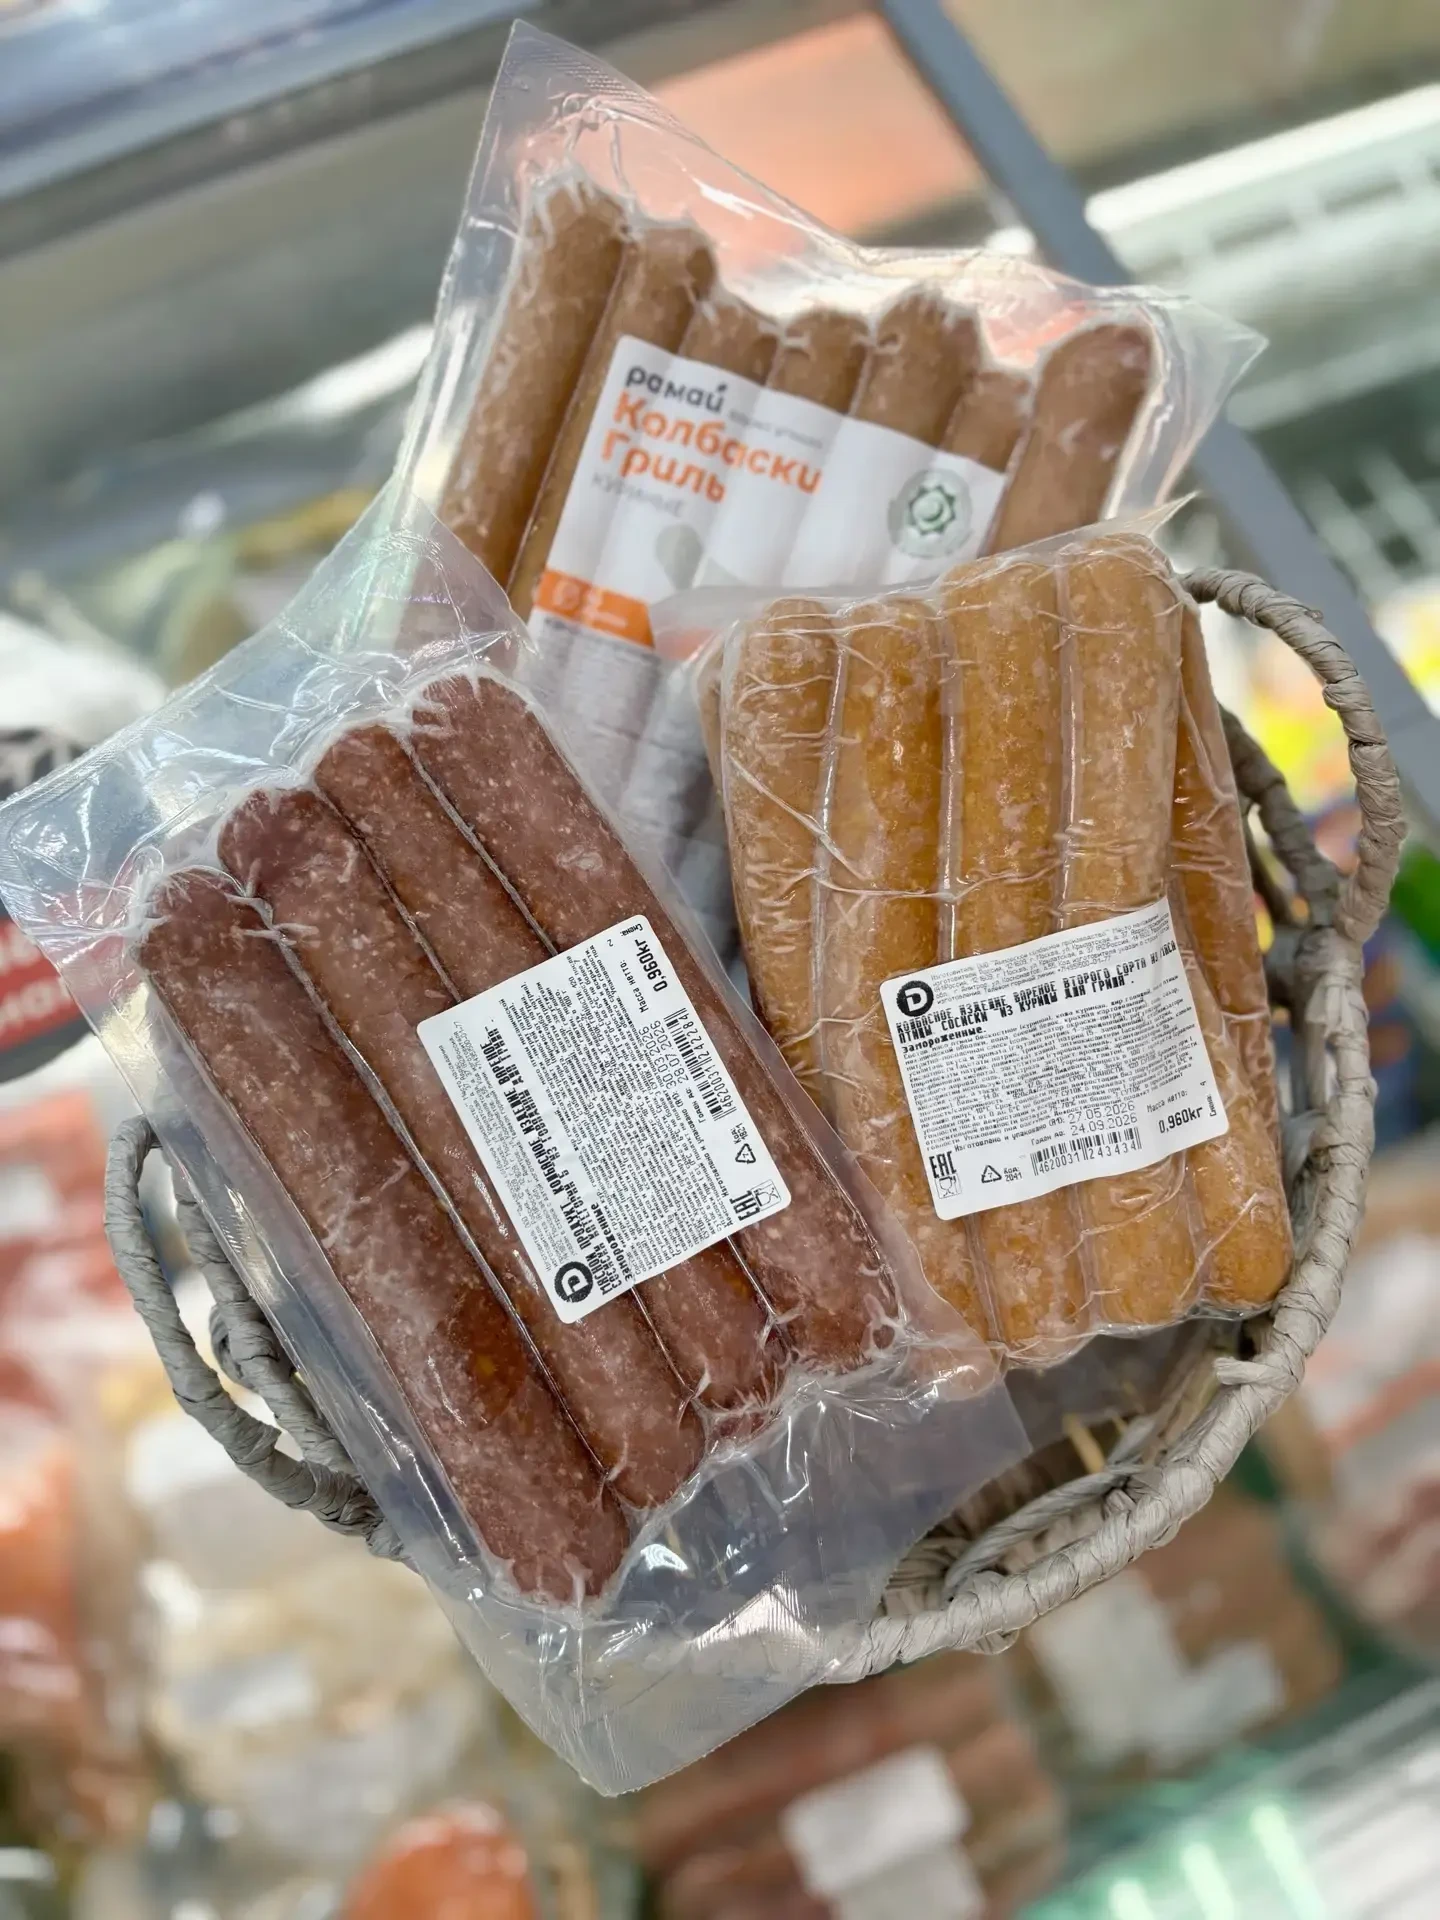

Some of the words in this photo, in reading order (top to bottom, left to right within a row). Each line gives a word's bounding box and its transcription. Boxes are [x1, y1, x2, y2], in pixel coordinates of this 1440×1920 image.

[626, 366, 728, 413] рамай
[612, 390, 823, 494] Колбаски
[601, 429, 726, 503] Гриль
[606, 938, 614, 947] 2
[619, 922, 643, 939] Смена:
[617, 959, 636, 986] нетто:
[895, 1007, 953, 1033] КОЛБАСНОЕ
[958, 994, 1008, 1017] ИЗДЕЛИЕ
[1013, 980, 1057, 1003] ВАРЕНОЕ
[1062, 967, 1111, 988] ВТОРОГО
[1115, 957, 1147, 975] СОРТА
[1149, 951, 1158, 964] ИЗ
[629, 986, 649, 1012] Масса
[941, 1010, 988, 1031] СОСИСКИ
[1018, 991, 1058, 1012] КУРИЦЫ
[1063, 984, 1086, 999] ДЛЯ
[648, 1019, 689, 1084] 28.07.2026
[678, 1012, 709, 1059] 242284
[901, 1024, 986, 1054] замороженные.
[504, 1063, 524, 1086] ДЛЯ
[638, 1025, 677, 1090] 30.03.2026
[683, 1086, 695, 1099] до:
[703, 1063, 735, 1109] 4620031
[1146, 1099, 1165, 1112] Масса
[1166, 1089, 1188, 1102] нетто:
[502, 1087, 535, 1135] ИЗДЕЛИЕ
[517, 1088, 552, 1143] ГОВЯДИНЫ
[680, 1107, 704, 1143] упаковано
[689, 1100, 706, 1123] Годен
[734, 1122, 749, 1140] 1821
[954, 1136, 1001, 1152] Изготовлено
[1011, 1124, 1046, 1140] упаковано
[1067, 1099, 1135, 1125] 27.05.2026
[1031, 1133, 1051, 1145] Годен
[1053, 1129, 1065, 1138] до:
[1069, 1110, 1138, 1137] 24.09.2026
[727, 1126, 741, 1144] Код:
[527, 1136, 564, 1195] КОЛБАСНОЕ
[557, 1168, 569, 1178] Б
[701, 1152, 729, 1198] Изготовлено
[1003, 1164, 1020, 1175] Код:
[1038, 1152, 1080, 1173] 4620031
[1088, 1139, 1137, 1159] 243434
[1005, 1171, 1022, 1183] 2041
[562, 1180, 599, 1239] КАТЕГОРИИ
[589, 1200, 636, 1281] замороженные
[592, 1241, 624, 1288] СОСИСКИ
